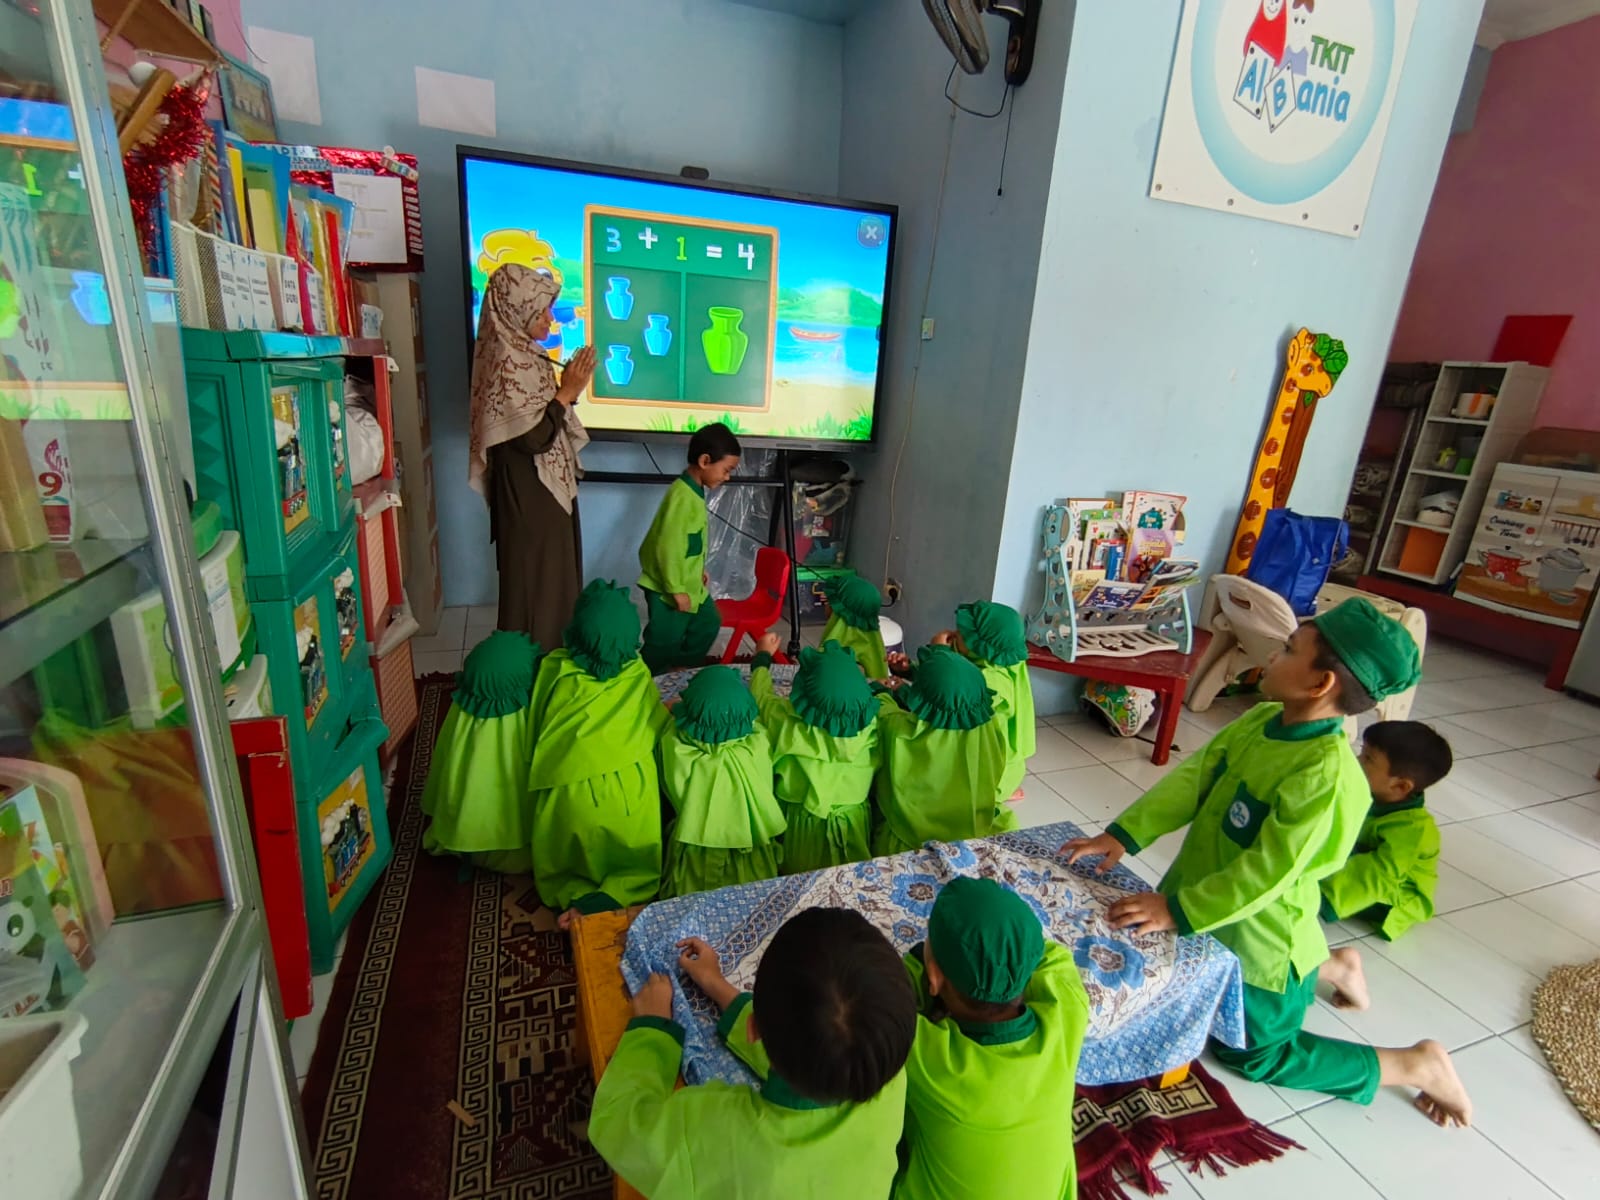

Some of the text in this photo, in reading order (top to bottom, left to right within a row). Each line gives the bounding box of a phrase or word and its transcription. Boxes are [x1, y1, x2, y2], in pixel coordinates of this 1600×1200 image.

[1310, 34, 1355, 75] TKIT
[1238, 57, 1269, 104] Al
[606, 227, 622, 253] 3
[676, 236, 687, 261] 1
[738, 243, 756, 270] 4
[38, 471, 63, 497] 9
